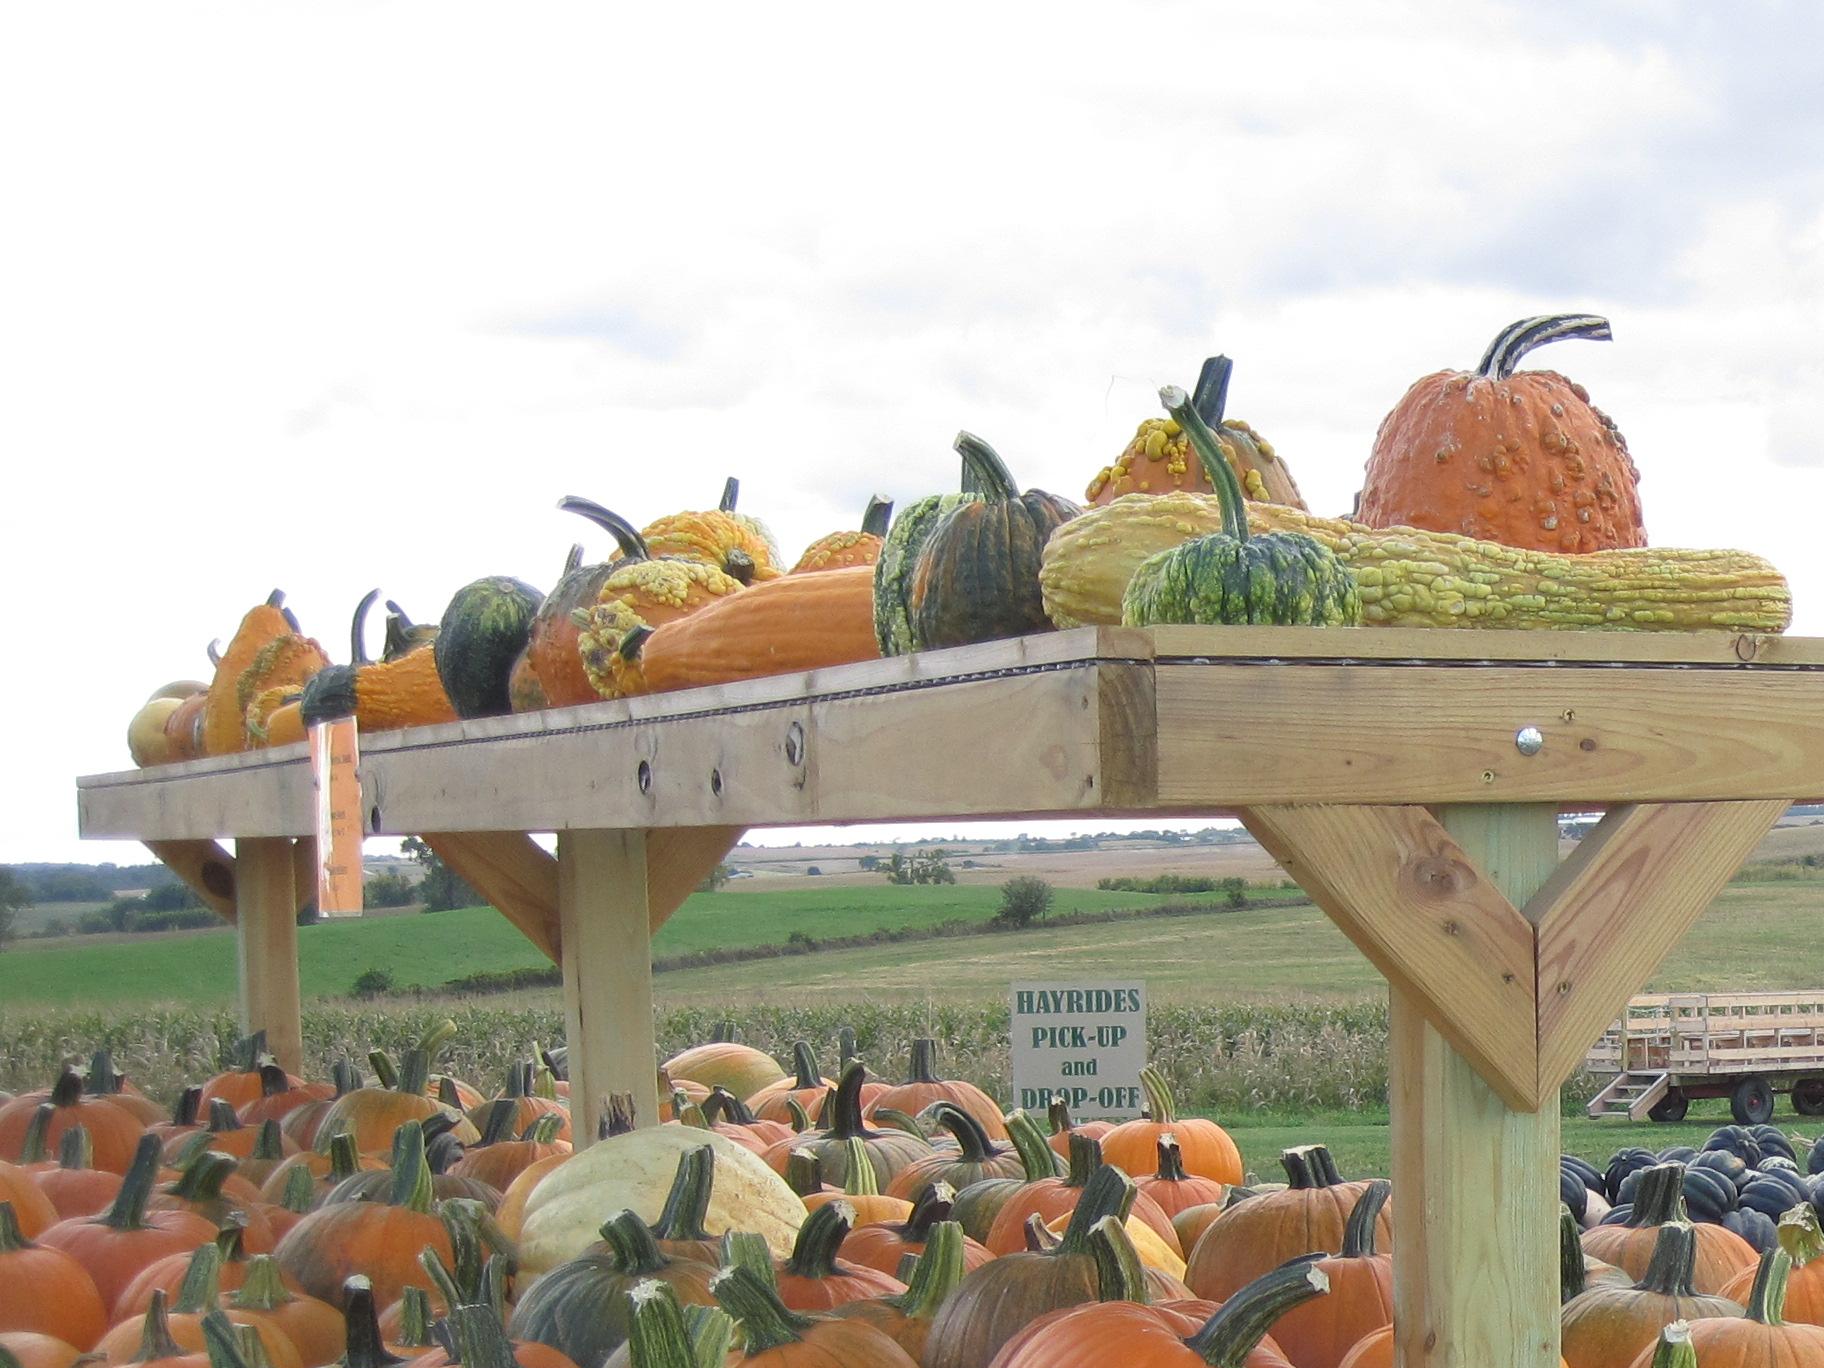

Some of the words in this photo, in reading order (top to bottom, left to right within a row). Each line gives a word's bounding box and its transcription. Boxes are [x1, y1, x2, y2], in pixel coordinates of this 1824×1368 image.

[1016, 988, 1140, 1014] HAYRIDES
[1032, 1025, 1127, 1049] PICK-UP
[1061, 1058, 1098, 1076] and
